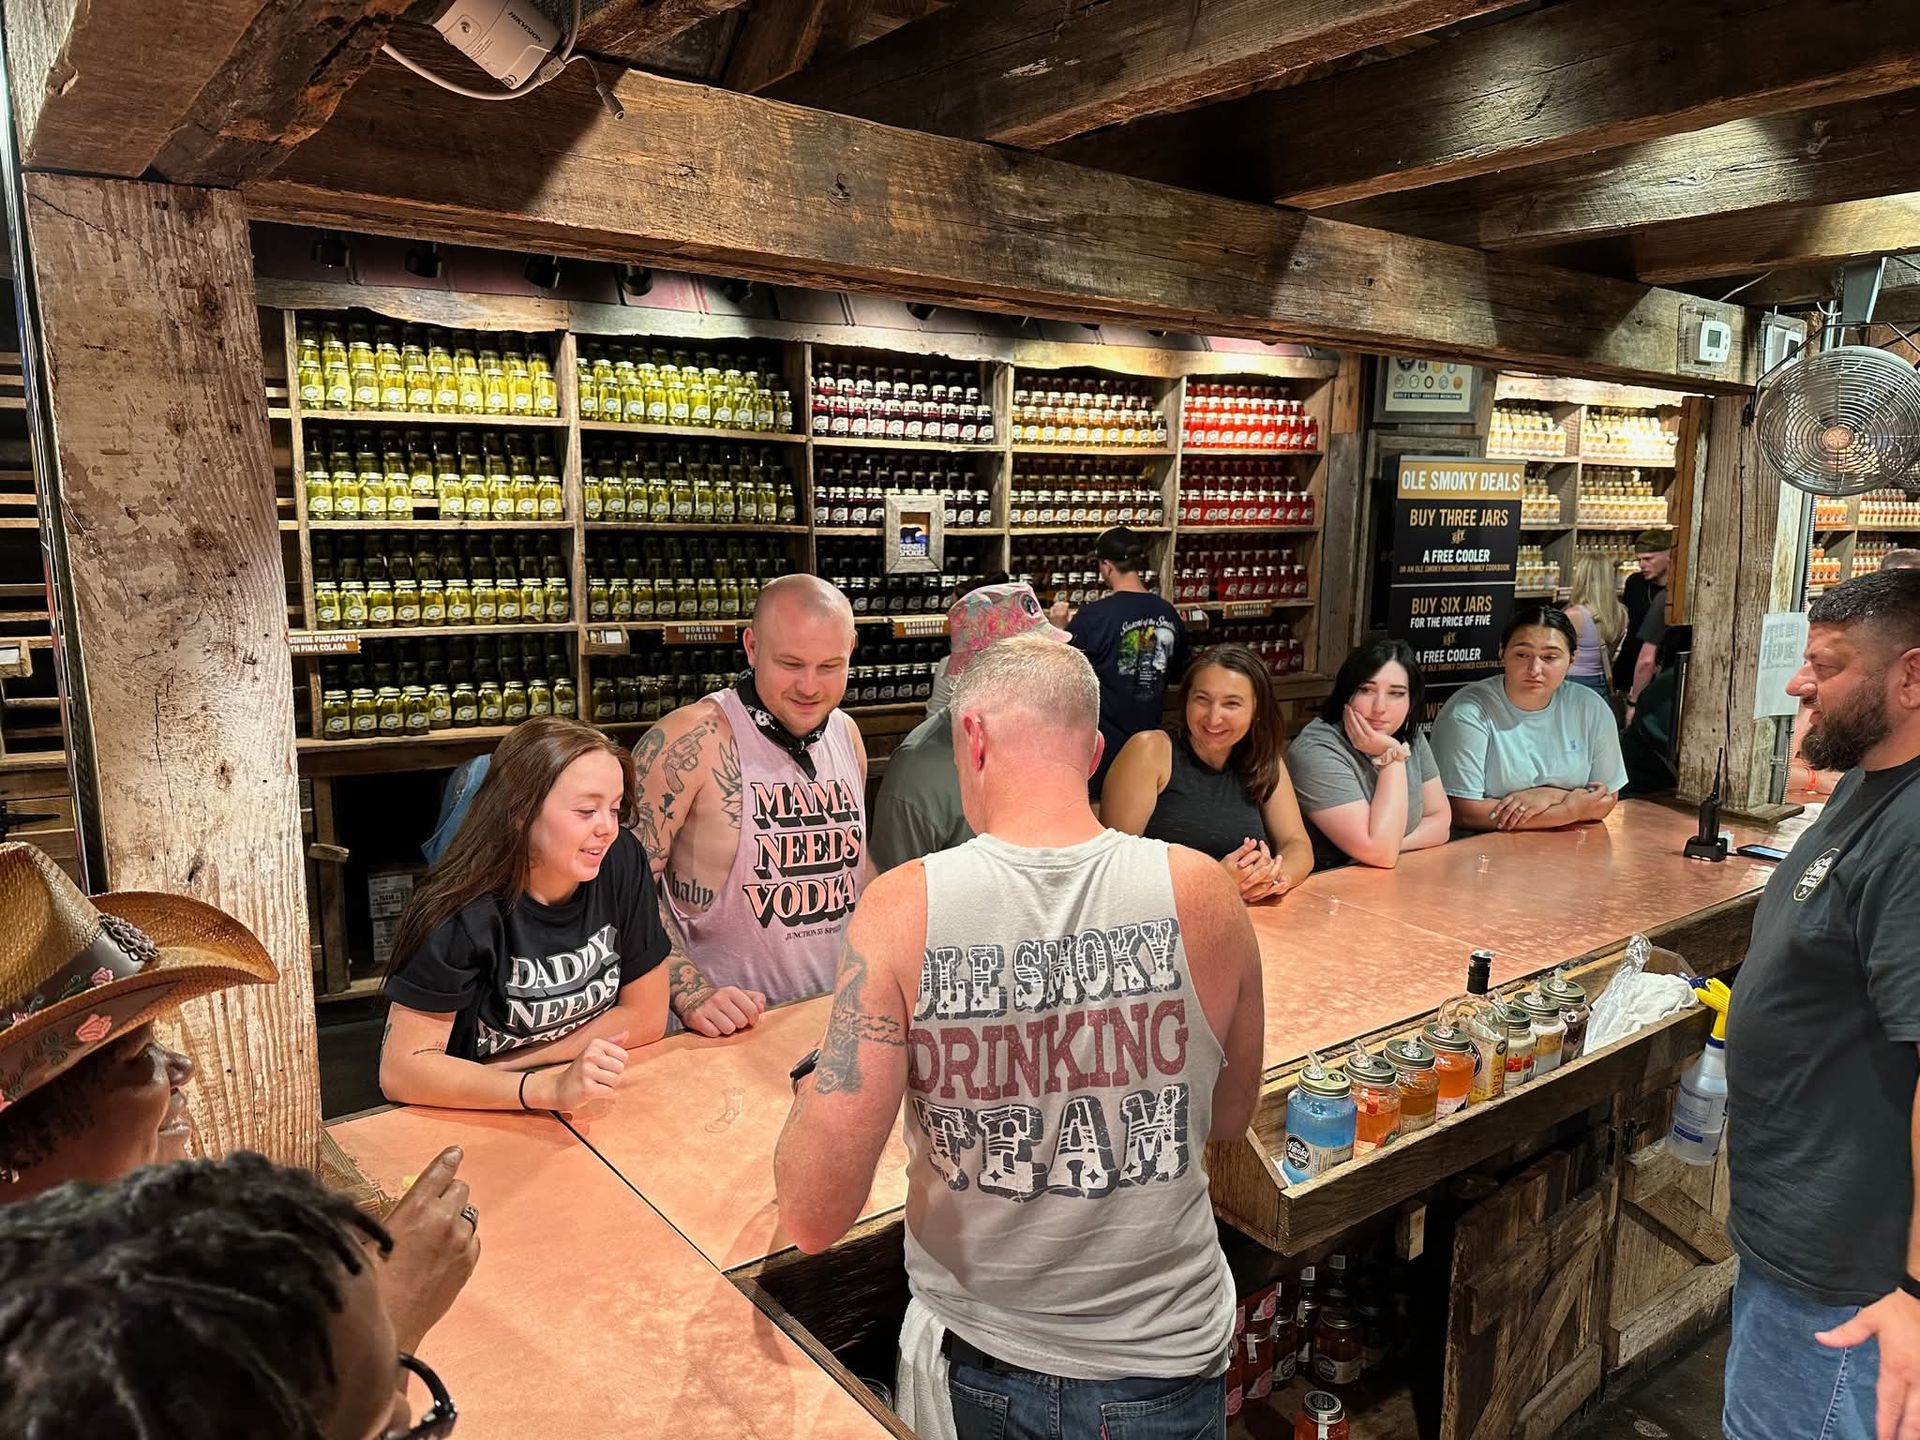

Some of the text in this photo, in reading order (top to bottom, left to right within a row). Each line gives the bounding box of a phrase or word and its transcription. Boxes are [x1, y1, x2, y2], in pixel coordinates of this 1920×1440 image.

[508, 11, 543, 43] HIKVISION
[1402, 470, 1520, 491] OLE SMOKY DEALS
[1409, 508, 1509, 526] BUY THREE JARS
[1423, 549, 1490, 563] A FREE COOLER
[1411, 595, 1492, 614] BUY SIX JARS
[1410, 614, 1491, 629] FOR THE PRICE OF FIVE
[314, 634, 356, 643] PINEAPPLES
[319, 643, 347, 652] COLADA
[1423, 650, 1445, 663] FREE
[1447, 648, 1481, 662] COOLER
[750, 779, 860, 829] MAMA
[753, 825, 862, 879] NEEDS
[743, 871, 856, 928] VODKA
[505, 923, 621, 998] DADDY
[1013, 918, 1182, 1013] SMOKY
[506, 963, 621, 1034] NEEDS
[908, 998, 1189, 1101] DRINKING
[912, 1083, 1190, 1203] TEAM
